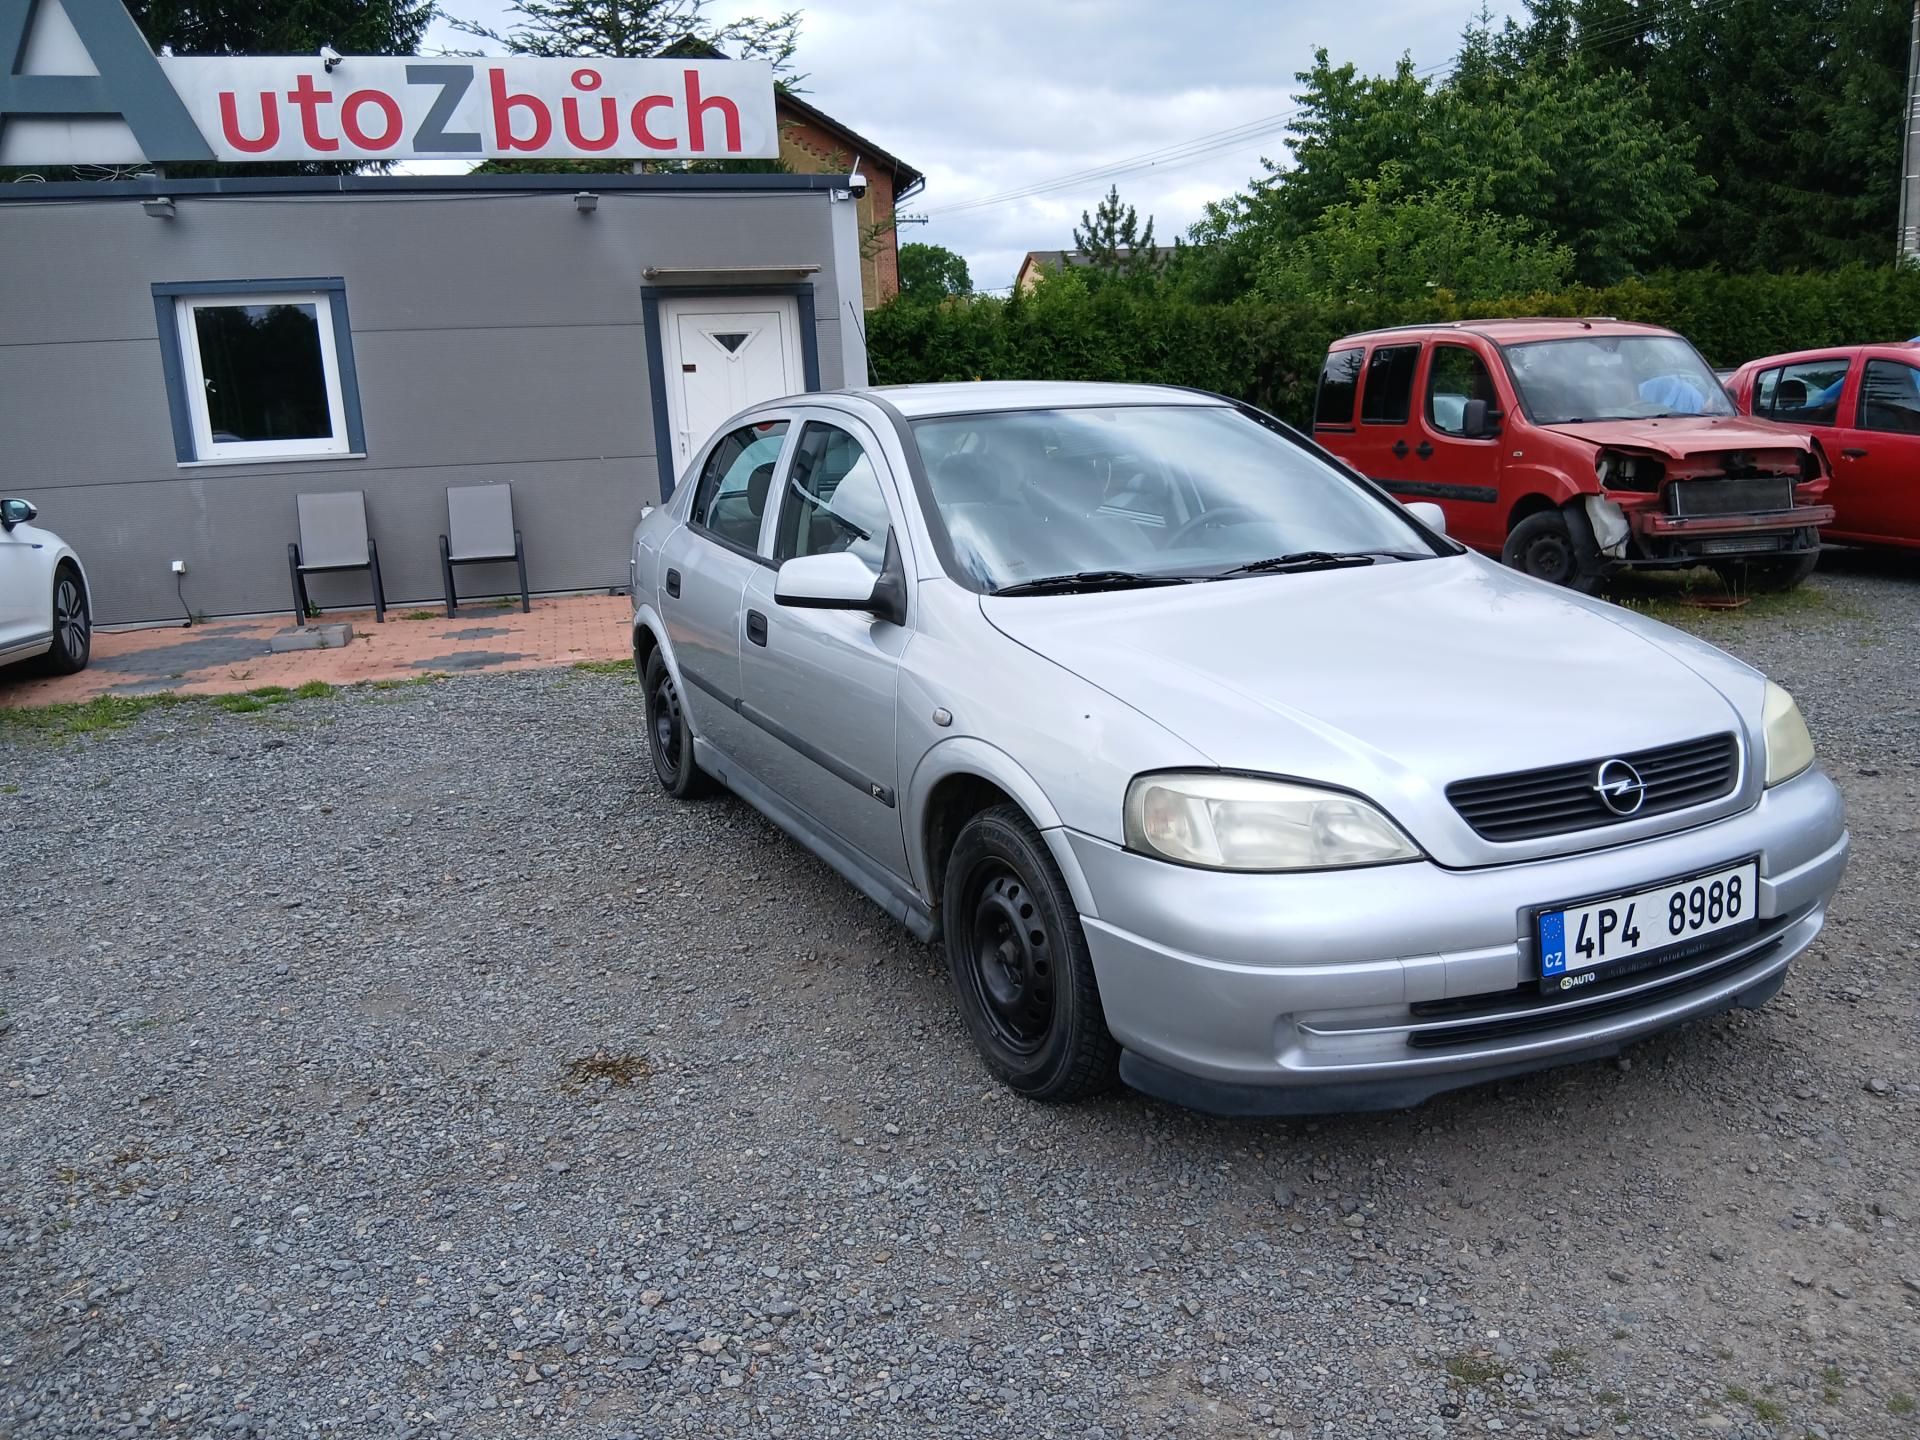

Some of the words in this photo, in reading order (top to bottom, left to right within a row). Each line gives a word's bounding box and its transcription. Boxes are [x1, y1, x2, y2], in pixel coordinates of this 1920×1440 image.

[0, 0, 742, 162] AutoZbůch
[1575, 903, 1641, 959] 4P4
[1668, 874, 1742, 936] 8988
[1545, 951, 1563, 968] CZ
